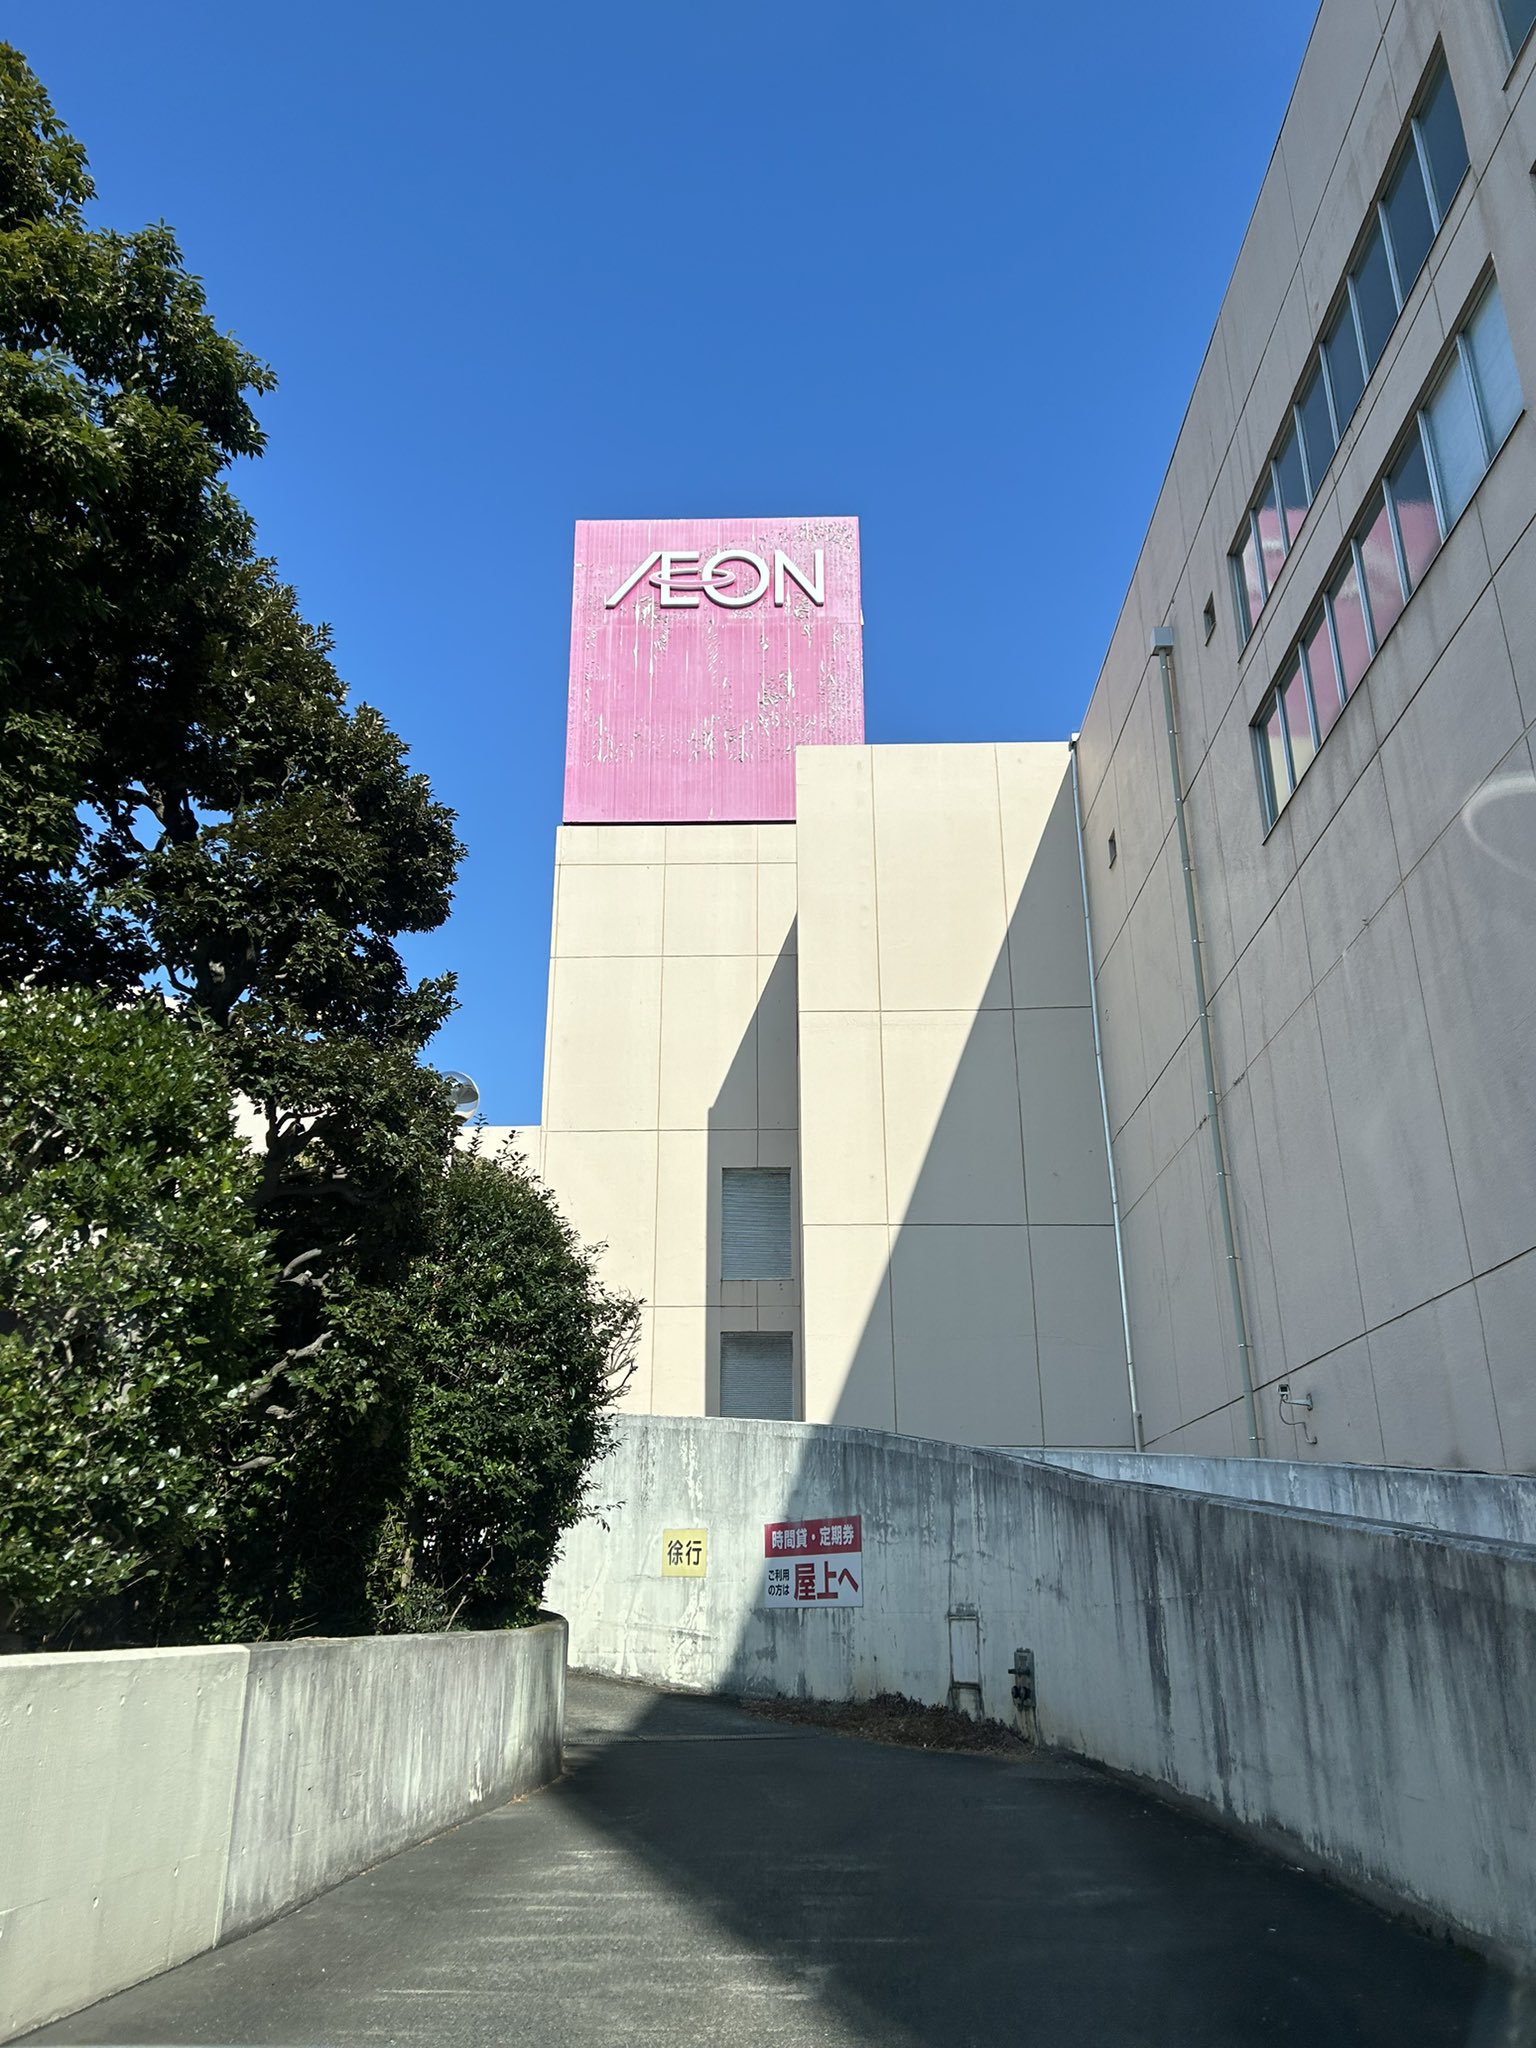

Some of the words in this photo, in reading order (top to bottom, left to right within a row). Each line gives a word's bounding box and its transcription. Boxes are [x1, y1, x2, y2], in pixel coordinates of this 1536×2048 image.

[771, 1524, 854, 1549] 時間貸・定期券
[667, 1539, 702, 1566] 徐行
[768, 1568, 790, 1582] ご利用
[793, 1560, 859, 1601] 屋上へ
[768, 1584, 790, 1597] の方は
